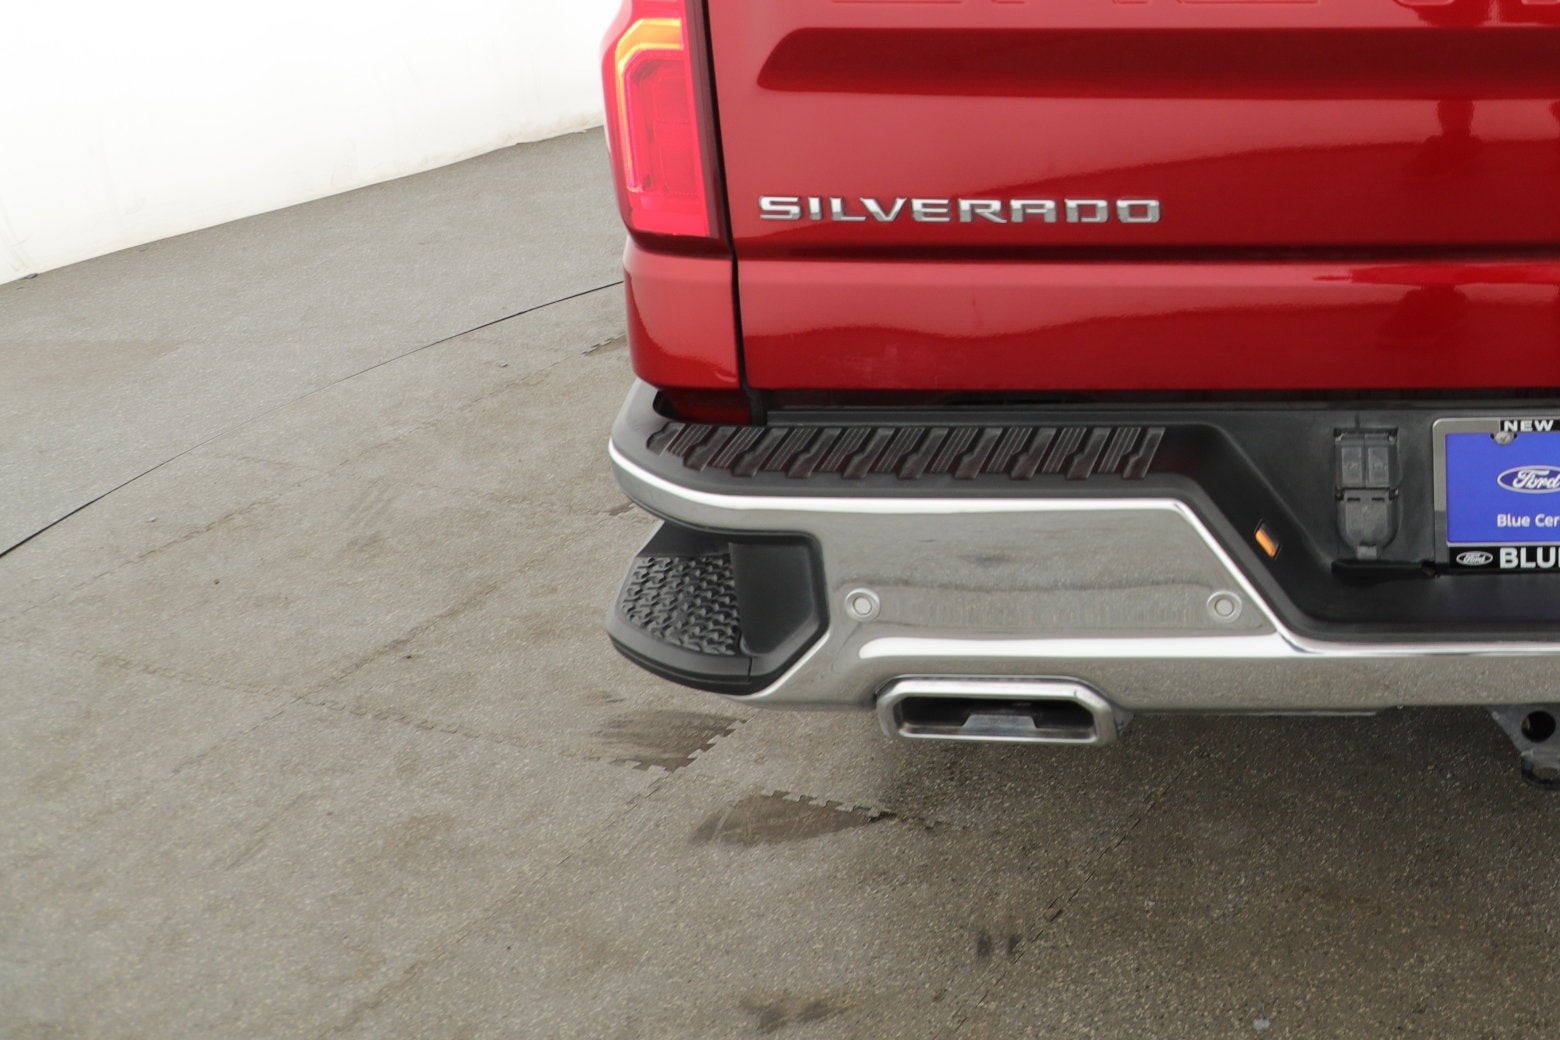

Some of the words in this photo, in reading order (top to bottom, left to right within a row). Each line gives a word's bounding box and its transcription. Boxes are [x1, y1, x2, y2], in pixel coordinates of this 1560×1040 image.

[758, 196, 1161, 224] SILVERADO
[1504, 419, 1553, 432] NEW
[1496, 513, 1531, 528] Blue
